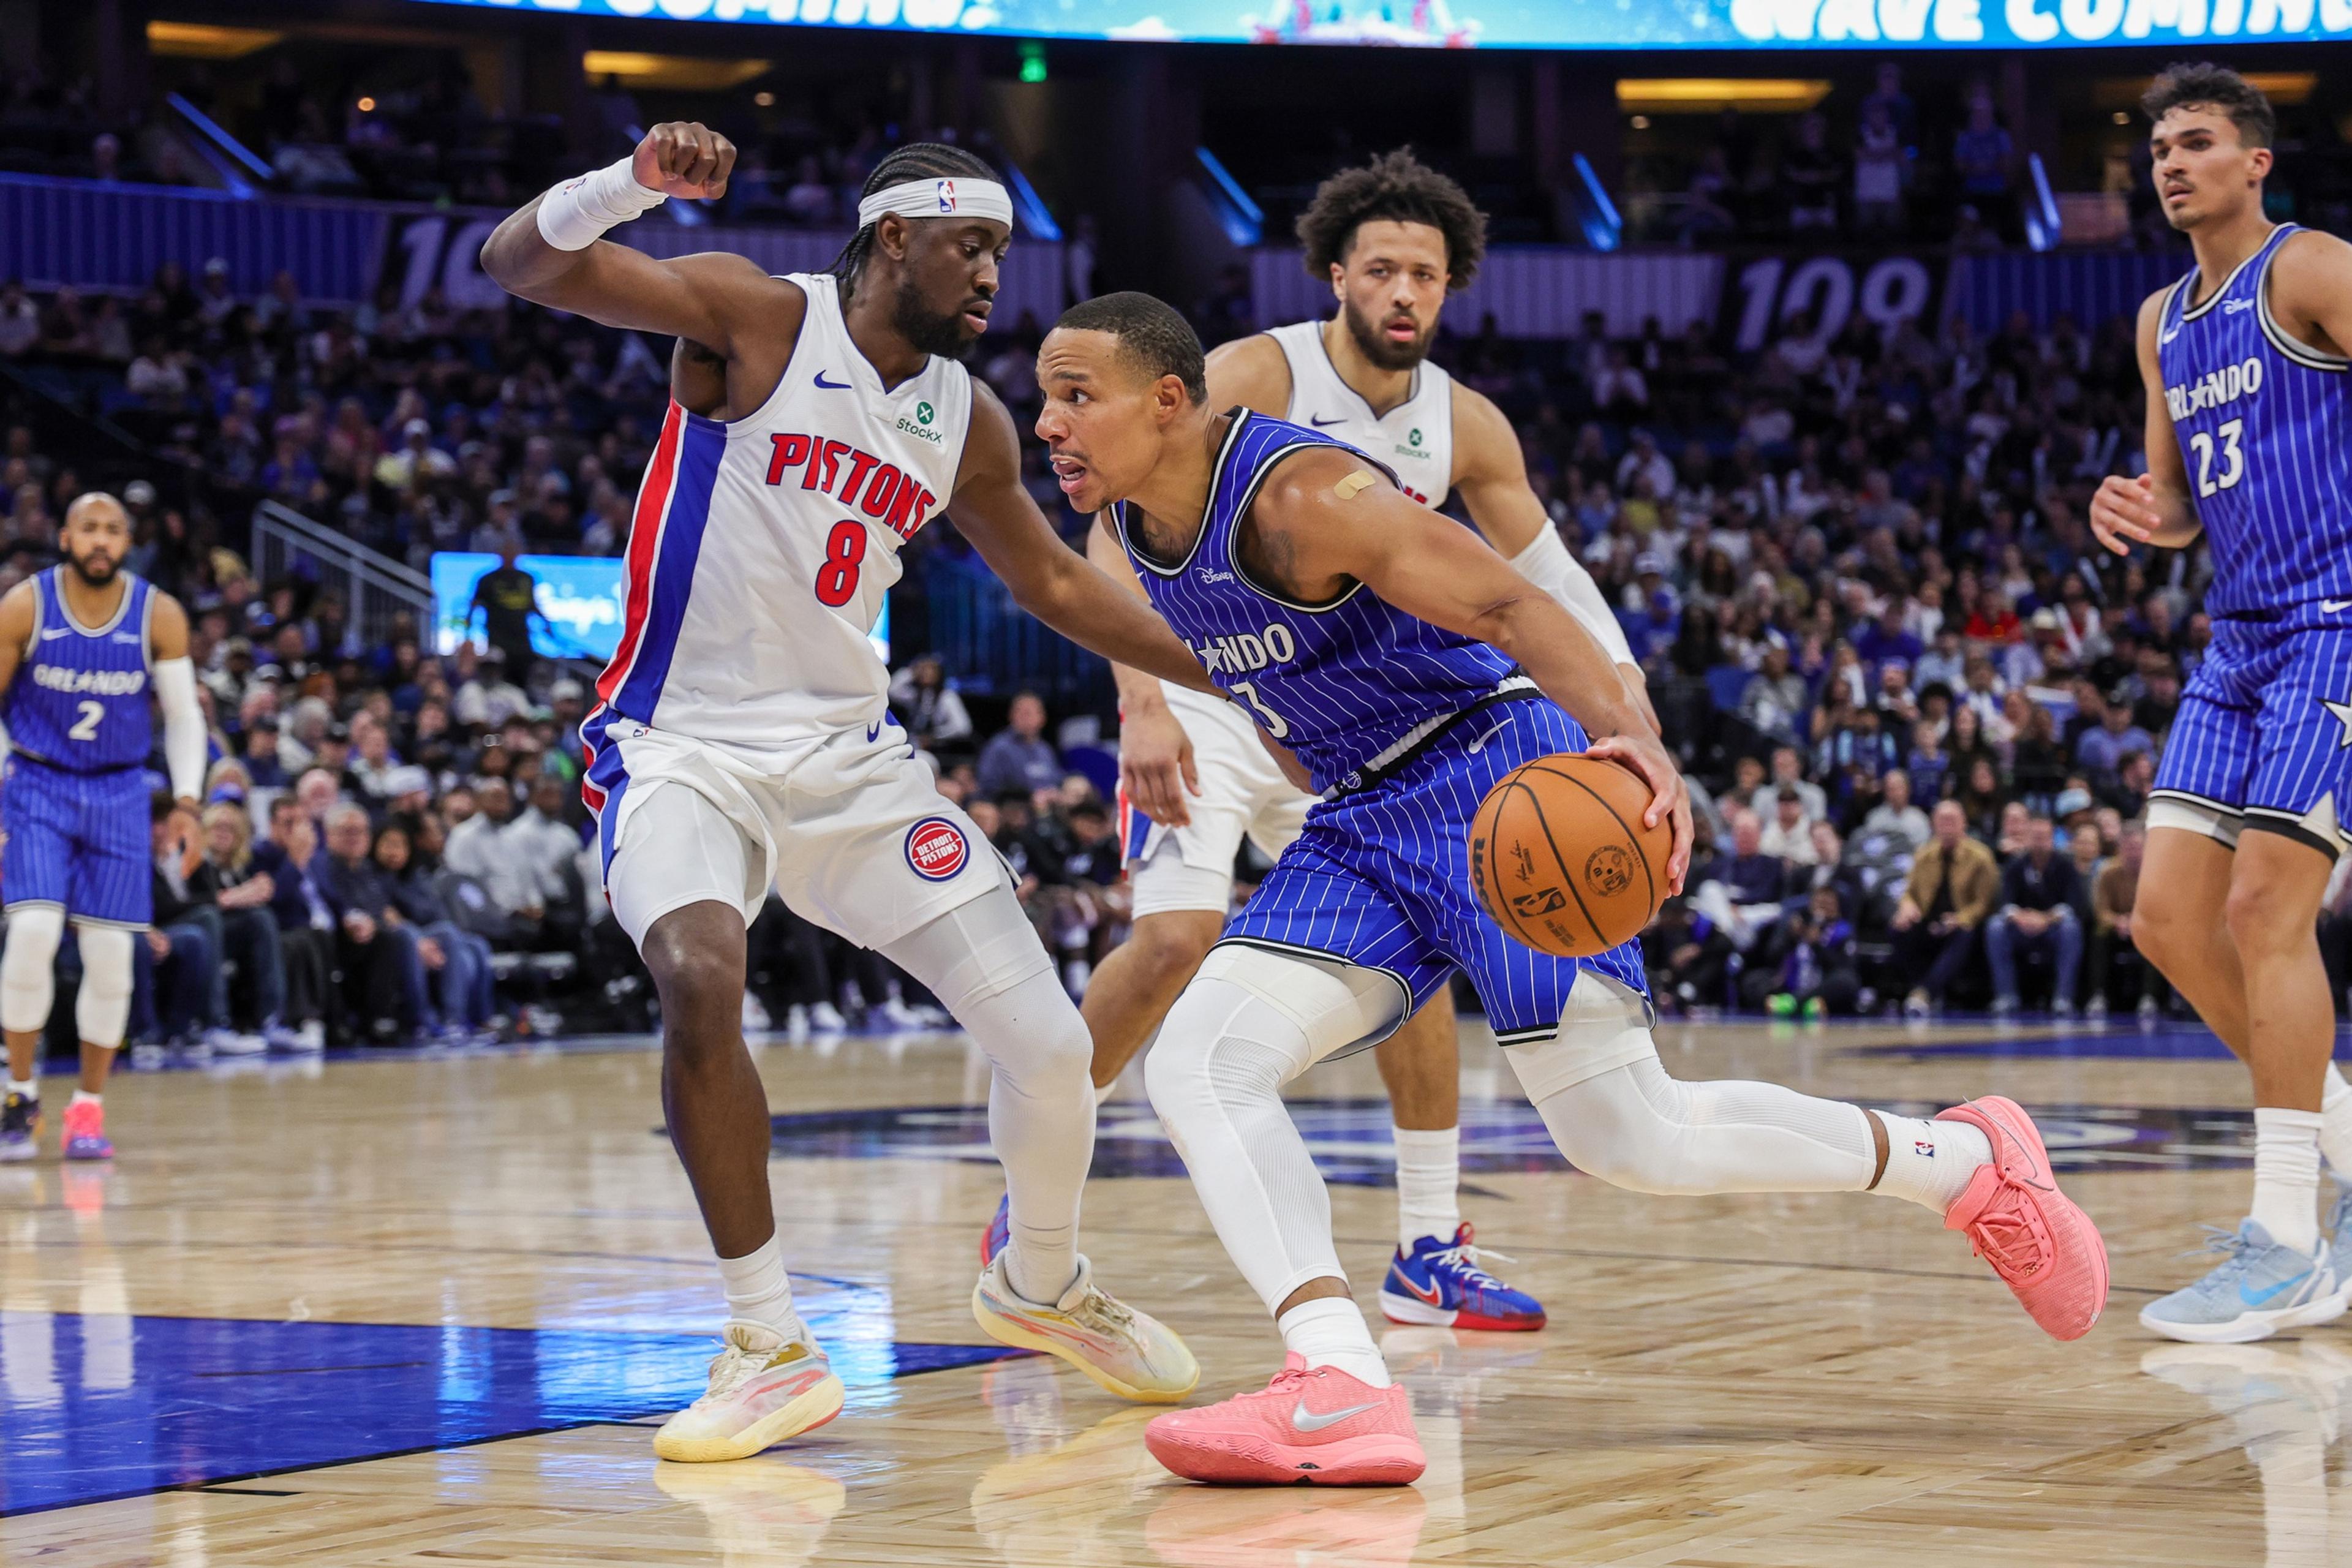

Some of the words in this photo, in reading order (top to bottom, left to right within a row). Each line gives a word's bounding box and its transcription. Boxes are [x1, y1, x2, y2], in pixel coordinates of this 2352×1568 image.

[766, 433, 936, 541] PISTONS
[2190, 418, 2244, 499] 23
[814, 519, 868, 608] 8
[69, 700, 105, 741] 2
[1229, 681, 1289, 739] 3
[916, 832, 953, 856] DETROIT
[920, 842, 959, 866] PISTONS
